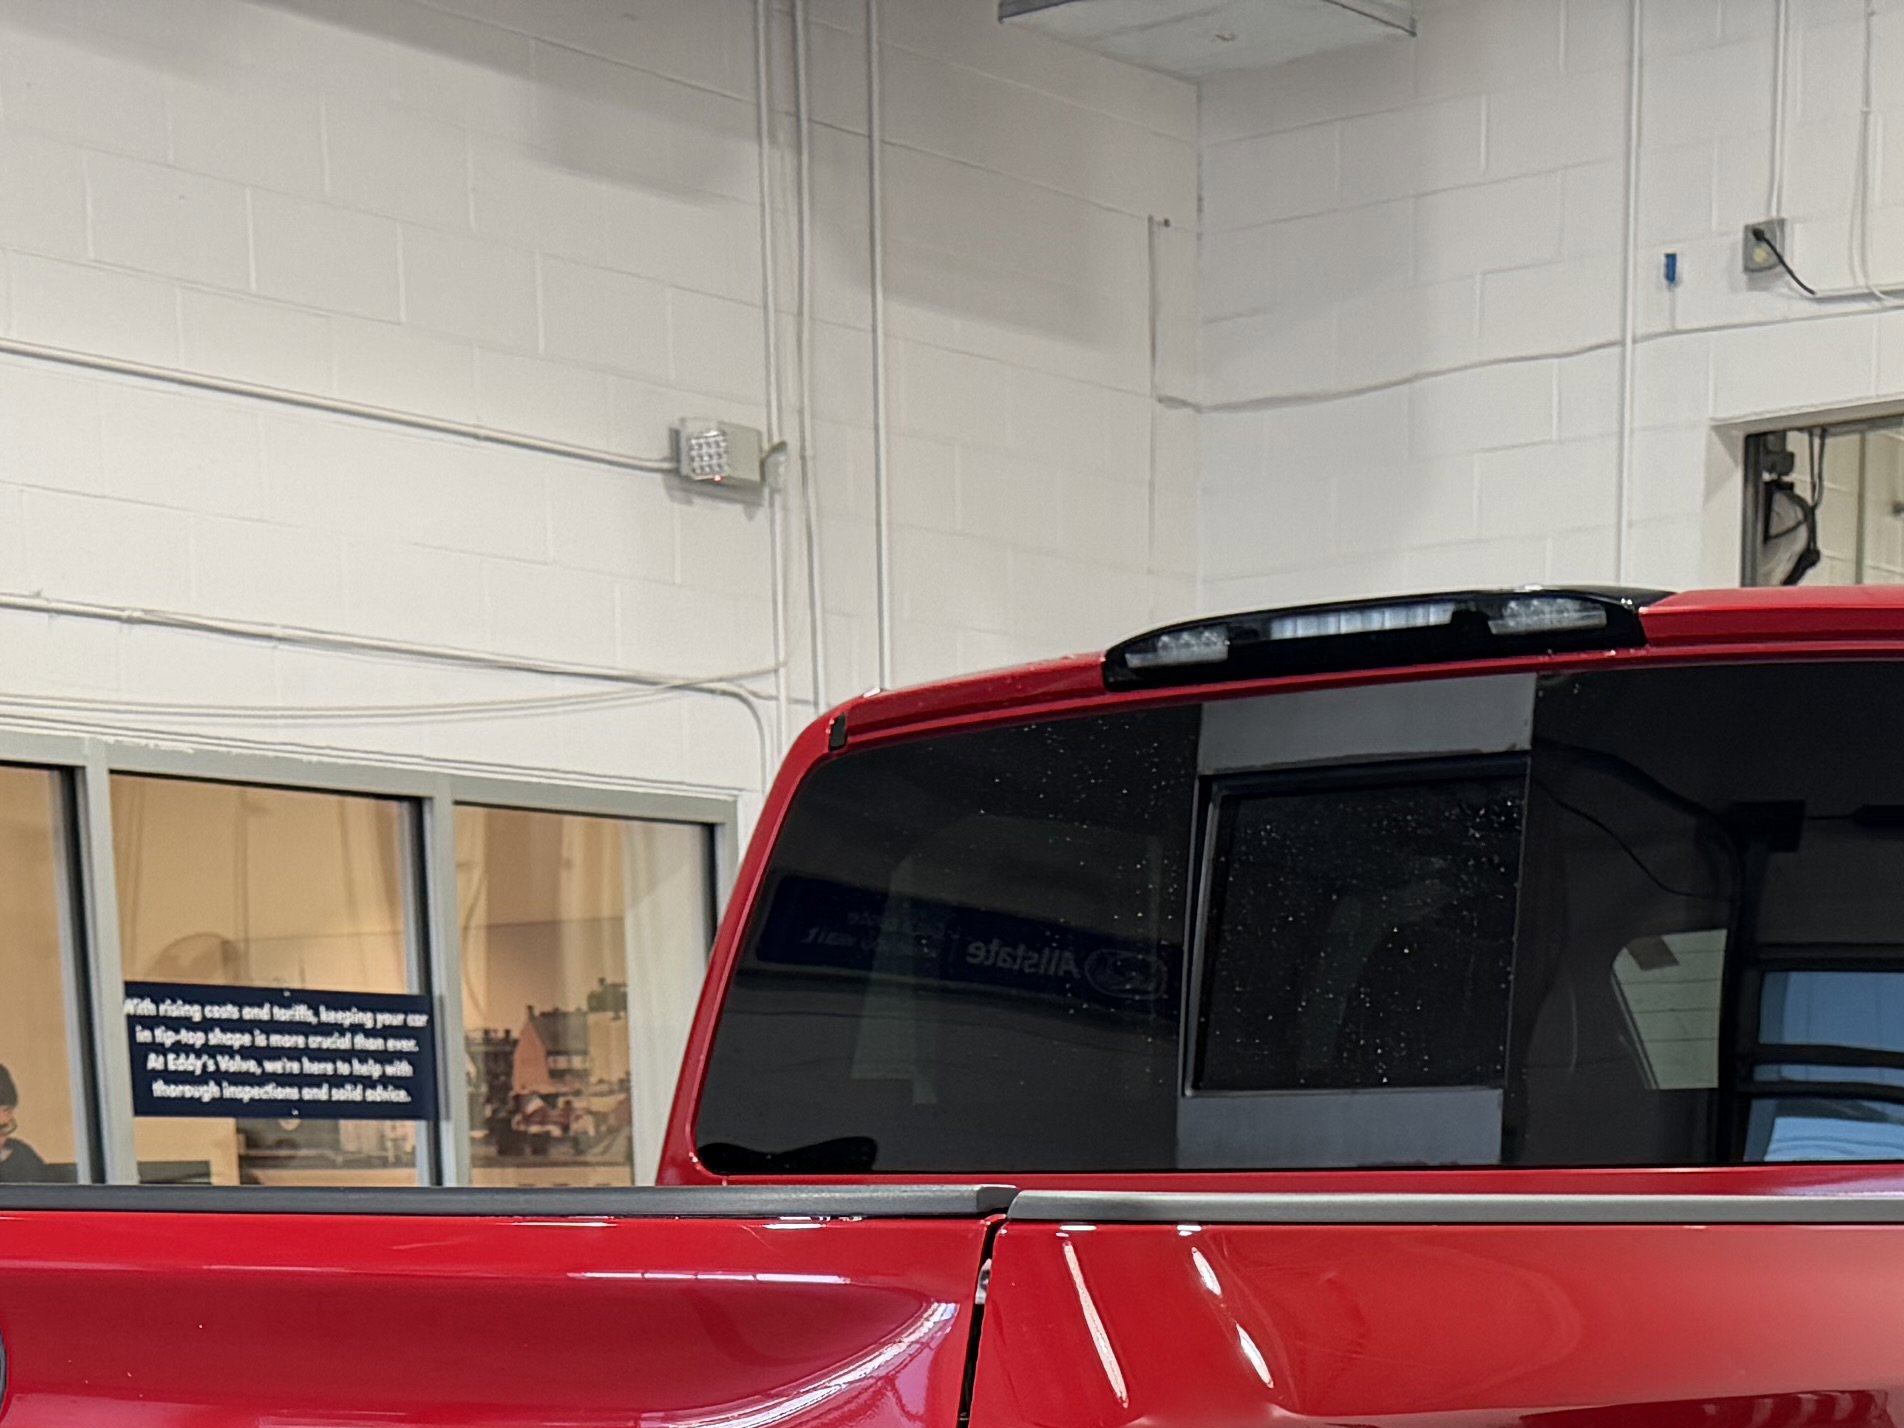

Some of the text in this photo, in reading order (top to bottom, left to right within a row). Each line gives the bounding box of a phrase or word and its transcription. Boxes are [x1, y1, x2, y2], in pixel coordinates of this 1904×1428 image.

[124, 998, 430, 1029] With rising costs and tariffs, keeping your car
[136, 1024, 419, 1052] in tip-top shape is more crucial than ever.
[147, 1052, 414, 1080] At Eddy's Volvo, we're here to help with
[152, 1079, 412, 1103] thorough inspections and solid advice.
